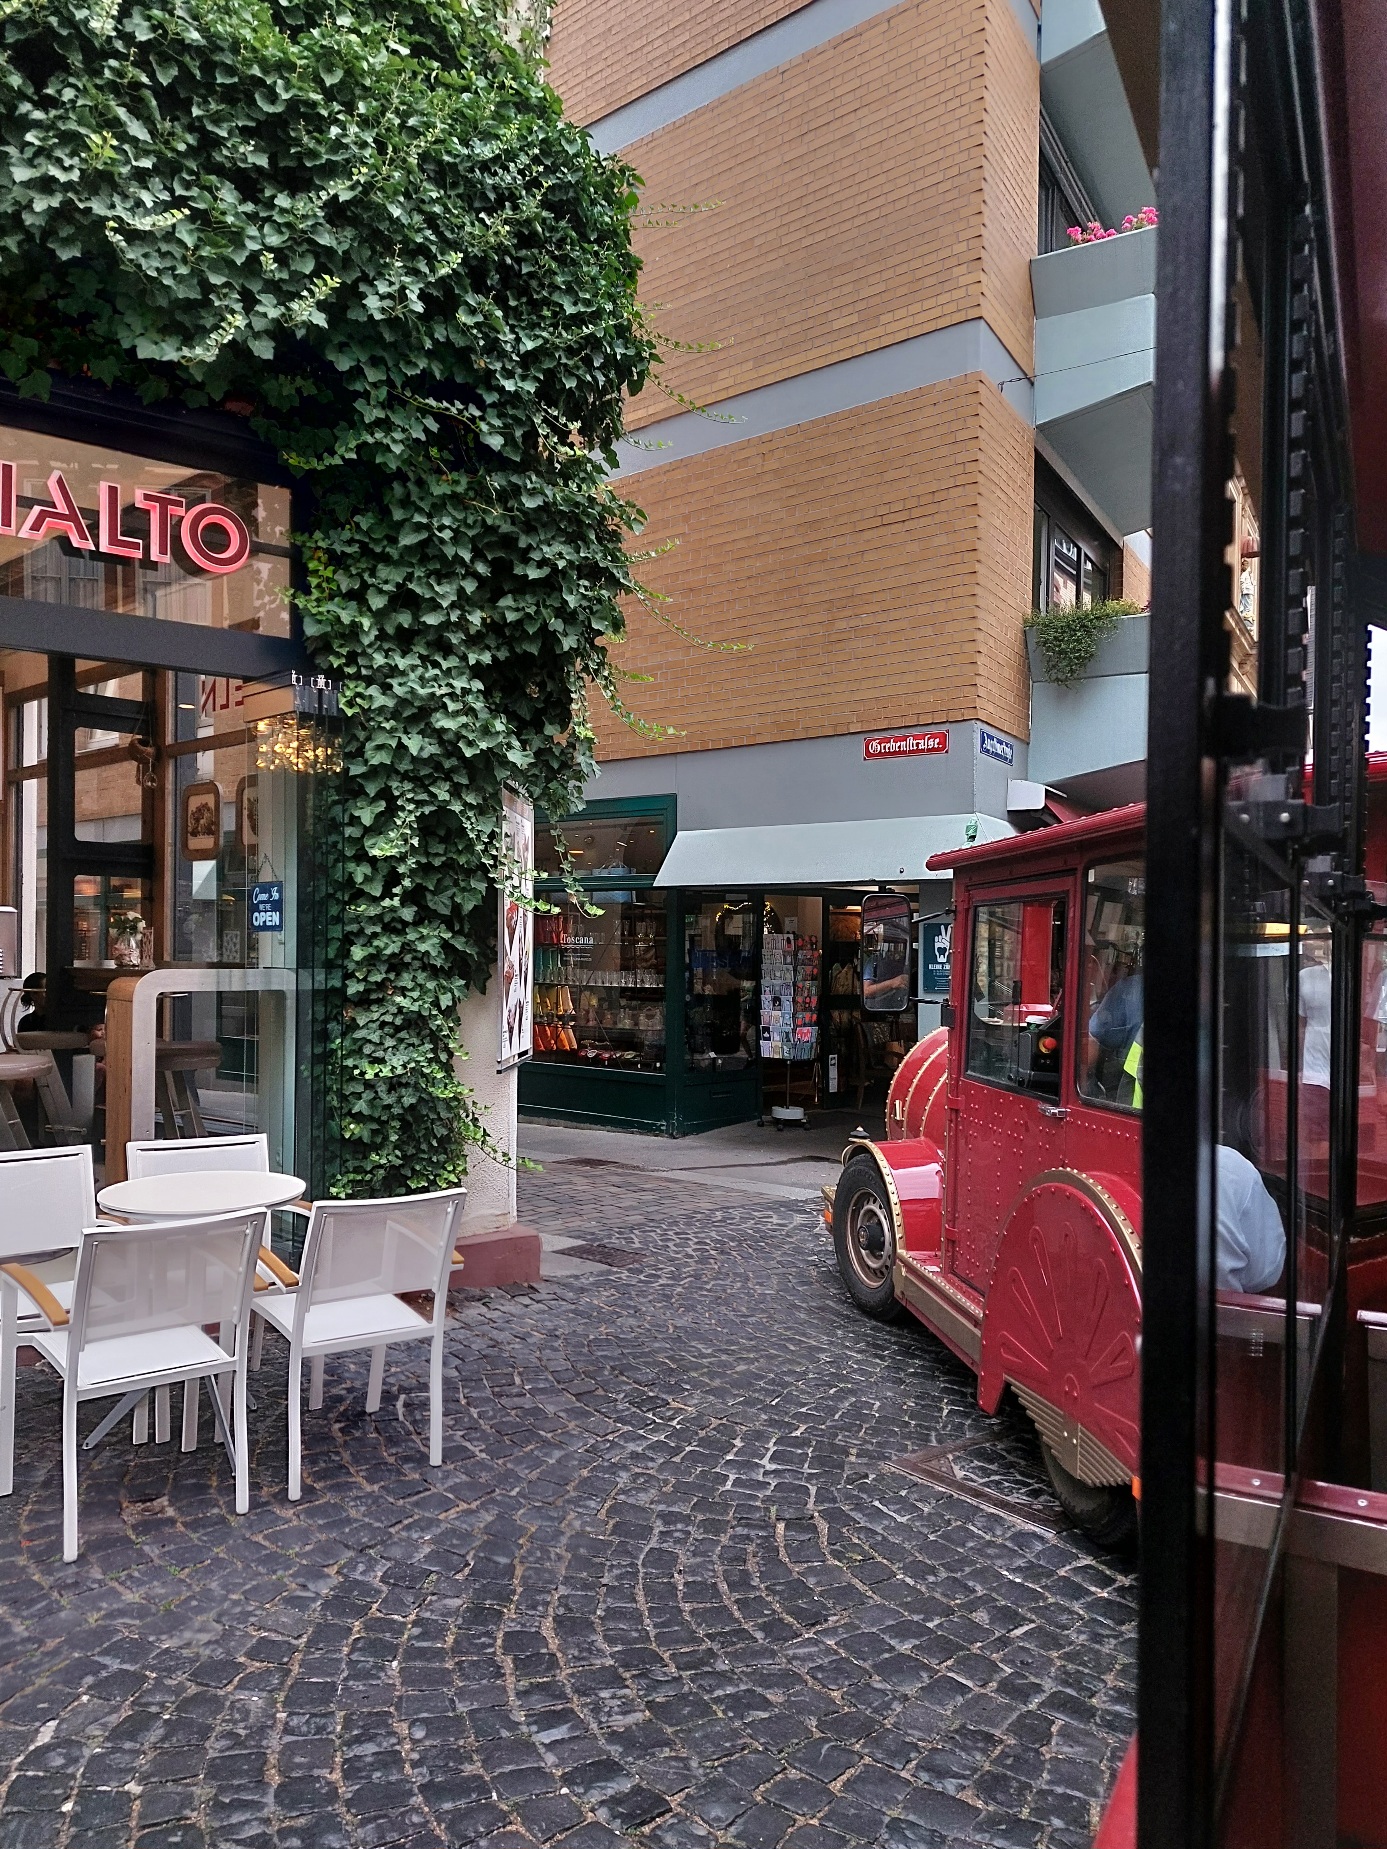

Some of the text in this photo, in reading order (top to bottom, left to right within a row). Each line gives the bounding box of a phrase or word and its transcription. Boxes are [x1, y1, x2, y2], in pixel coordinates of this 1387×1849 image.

[252, 887, 269, 904] Come
[258, 903, 272, 911] WE'RE
[252, 911, 280, 927] OPEN
[562, 933, 594, 944] Toscana
